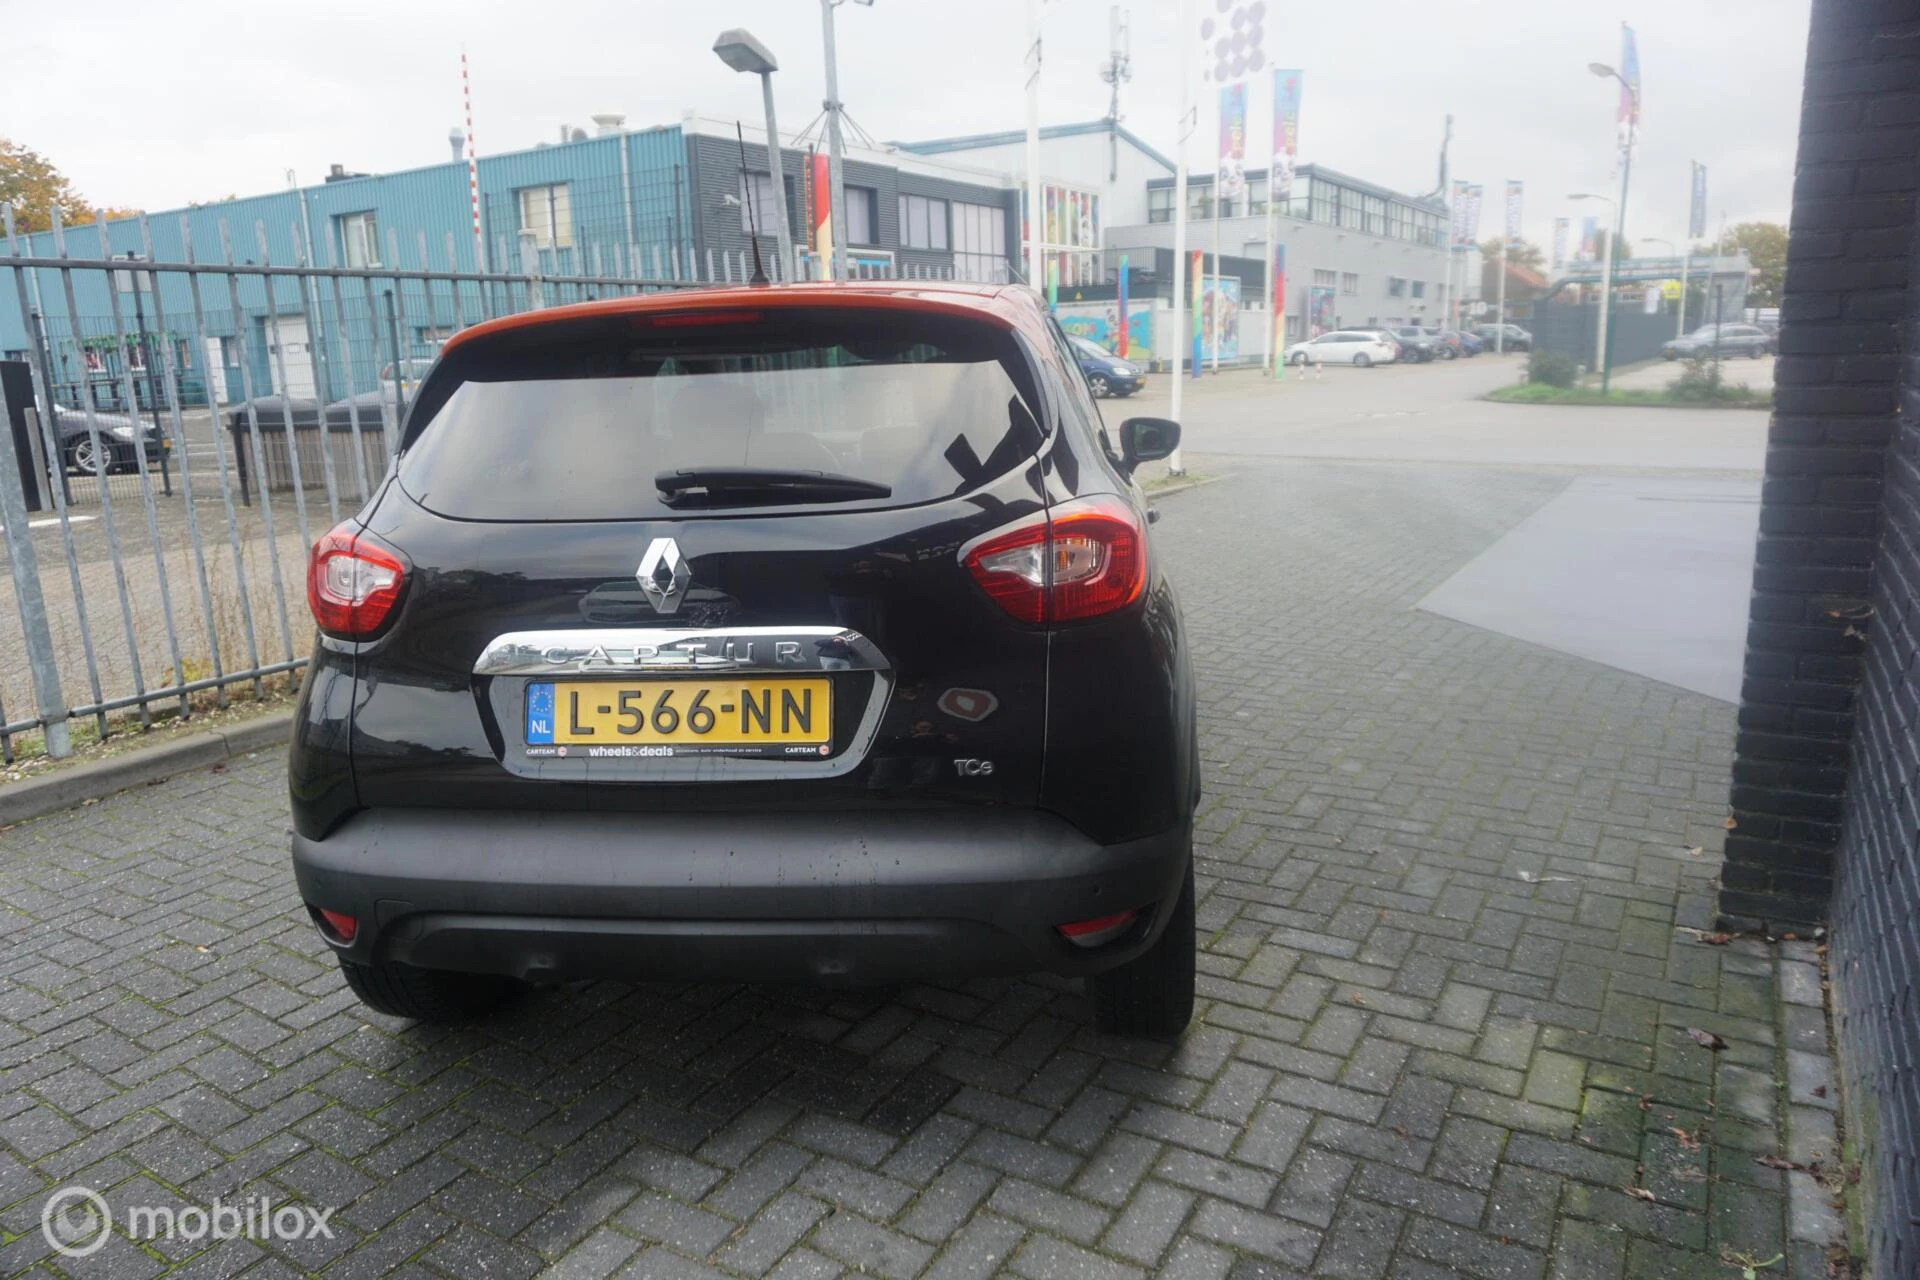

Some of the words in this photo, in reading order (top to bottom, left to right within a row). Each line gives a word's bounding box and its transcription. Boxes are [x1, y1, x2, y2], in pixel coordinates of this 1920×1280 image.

[541, 640, 808, 665] CAPTUR
[569, 689, 812, 735] L-566-NN
[531, 720, 551, 734] NL
[589, 746, 673, 757] wheels&deals
[954, 759, 993, 776] TCe
